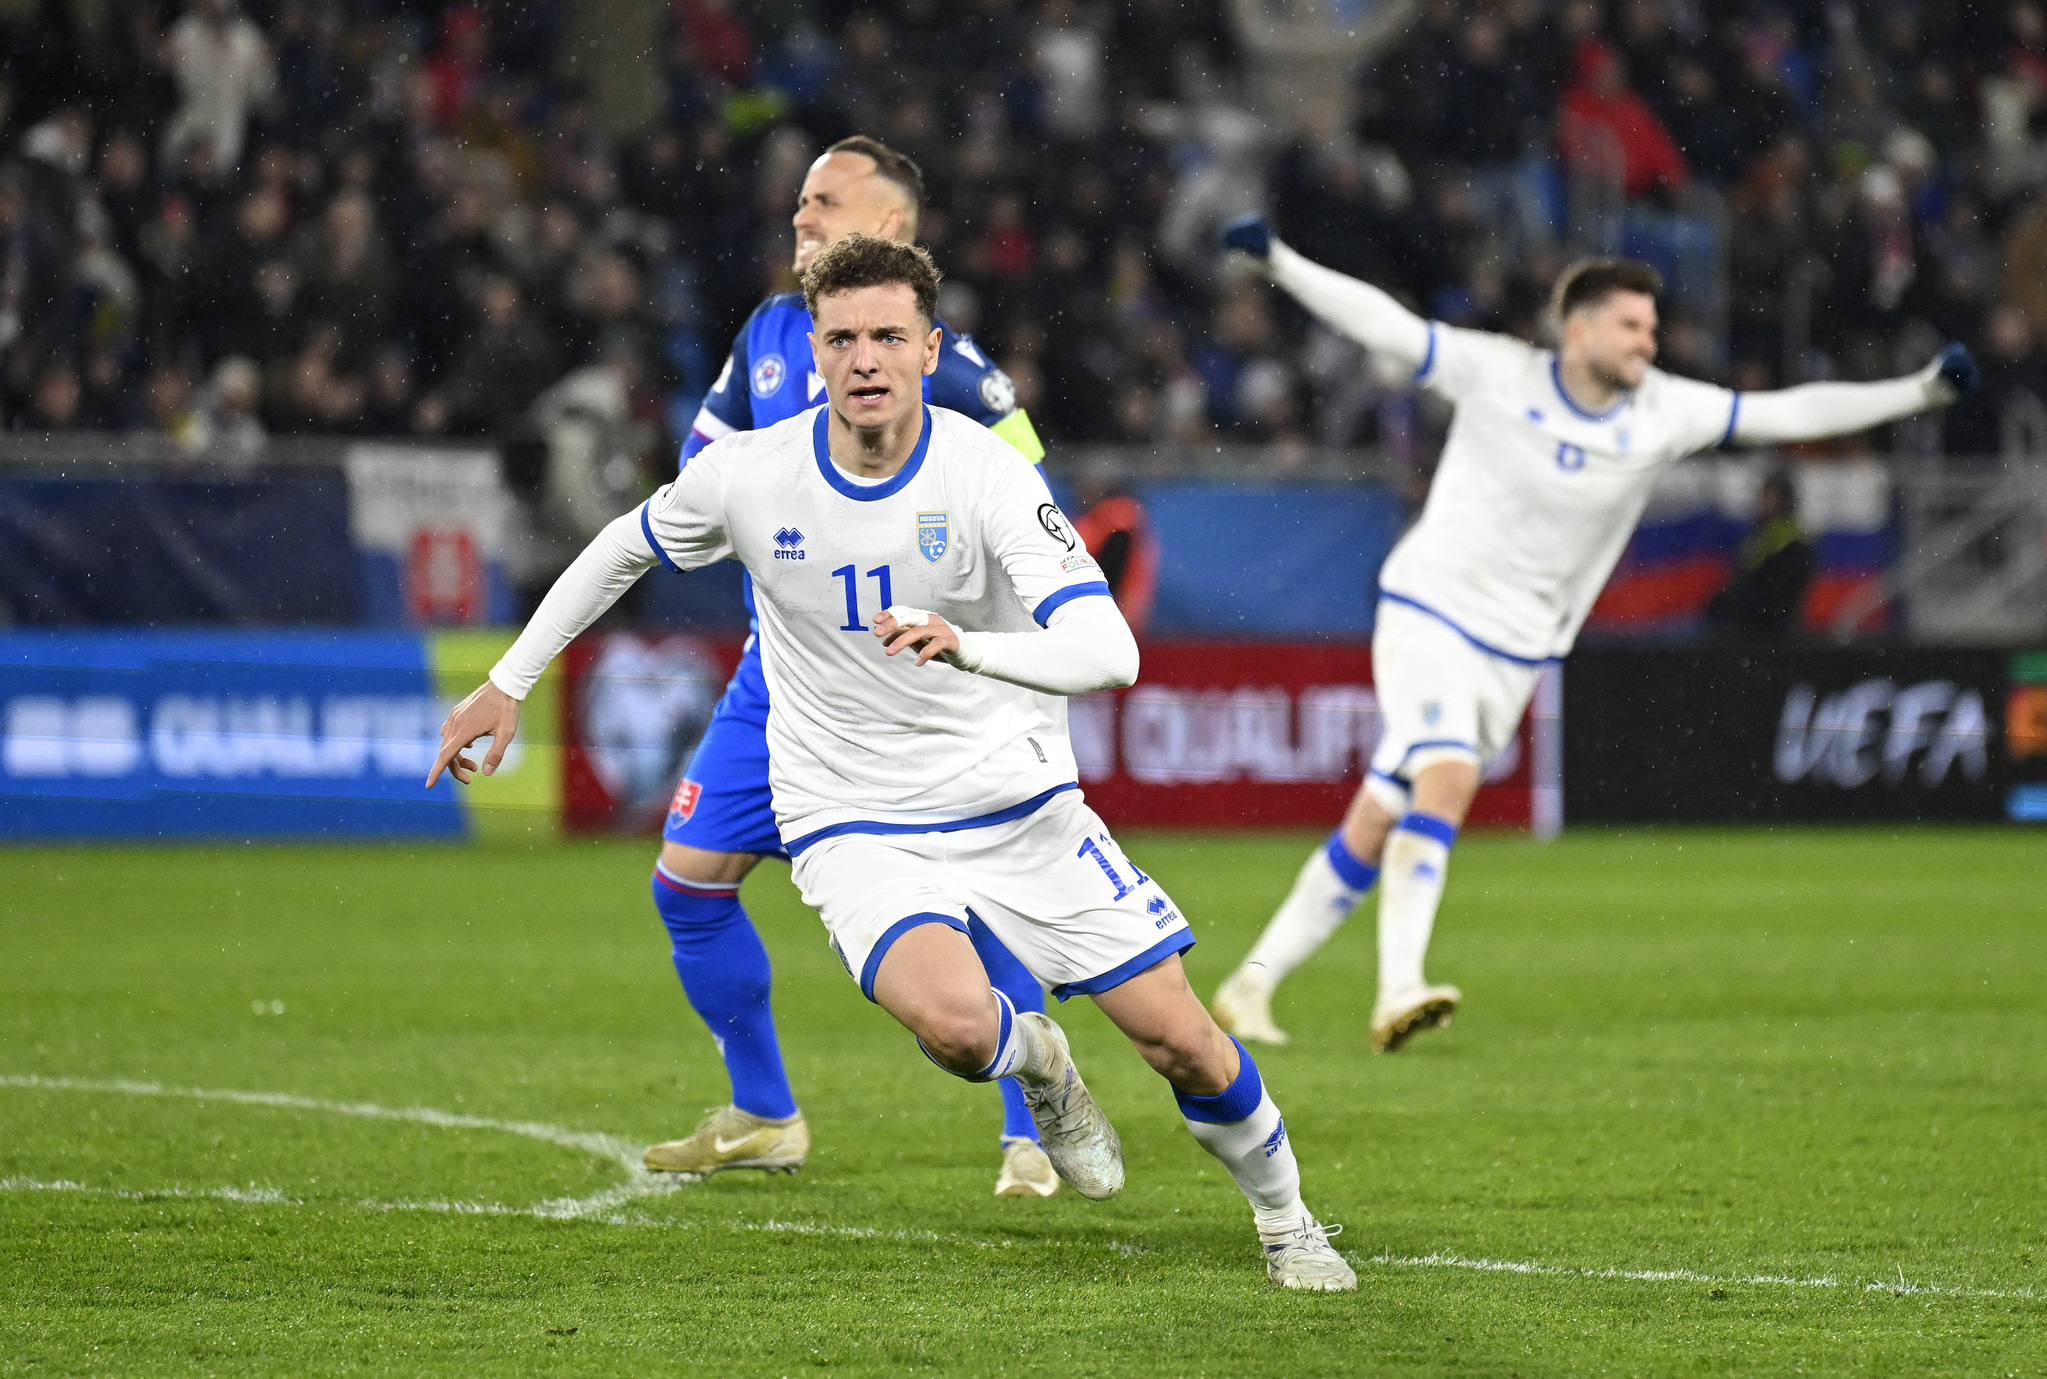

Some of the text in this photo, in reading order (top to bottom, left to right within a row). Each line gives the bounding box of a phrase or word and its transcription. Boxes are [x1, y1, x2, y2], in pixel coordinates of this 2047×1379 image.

[774, 549, 805, 560] errea
[831, 563, 894, 632] 11
[1774, 677, 1988, 788] UEFA
[1155, 910, 1178, 930] errea
